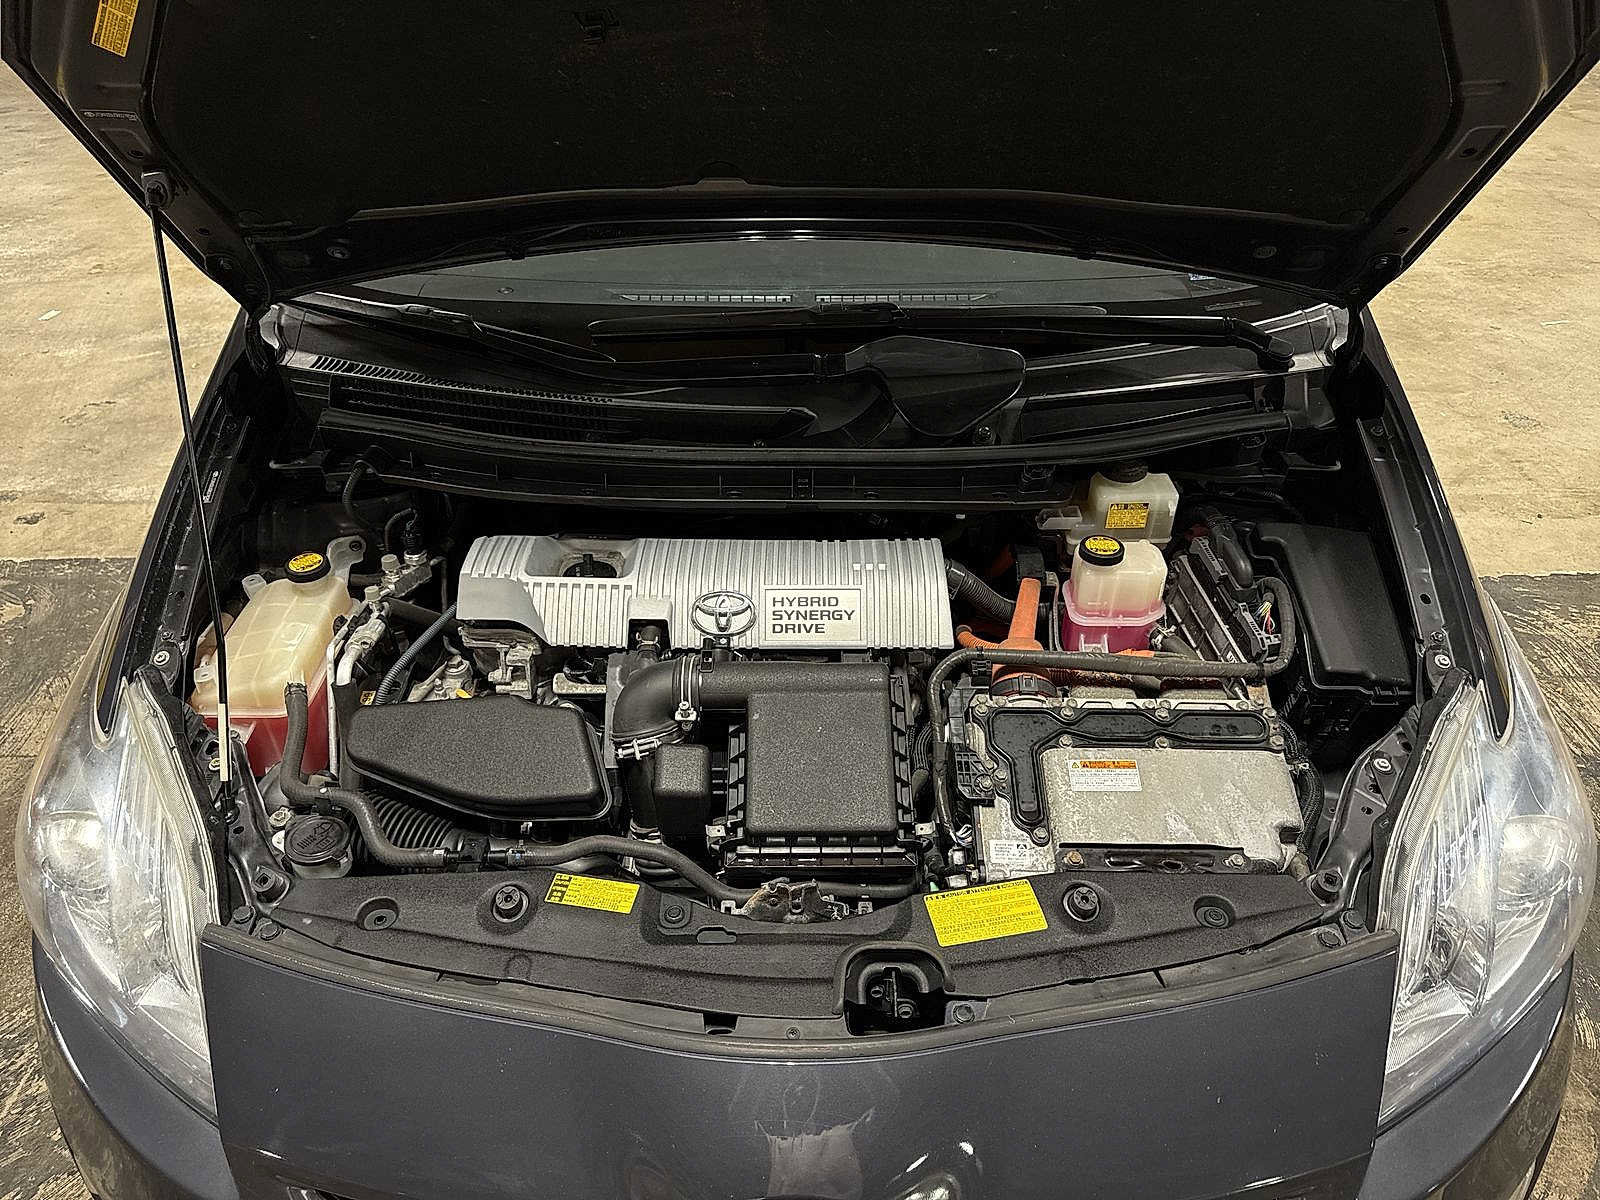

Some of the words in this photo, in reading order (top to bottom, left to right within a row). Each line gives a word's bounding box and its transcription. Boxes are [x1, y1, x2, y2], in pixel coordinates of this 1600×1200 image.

[772, 596, 839, 607] HYBRID
[772, 609, 855, 621] SYNERGY
[772, 623, 826, 634] DRIVE
